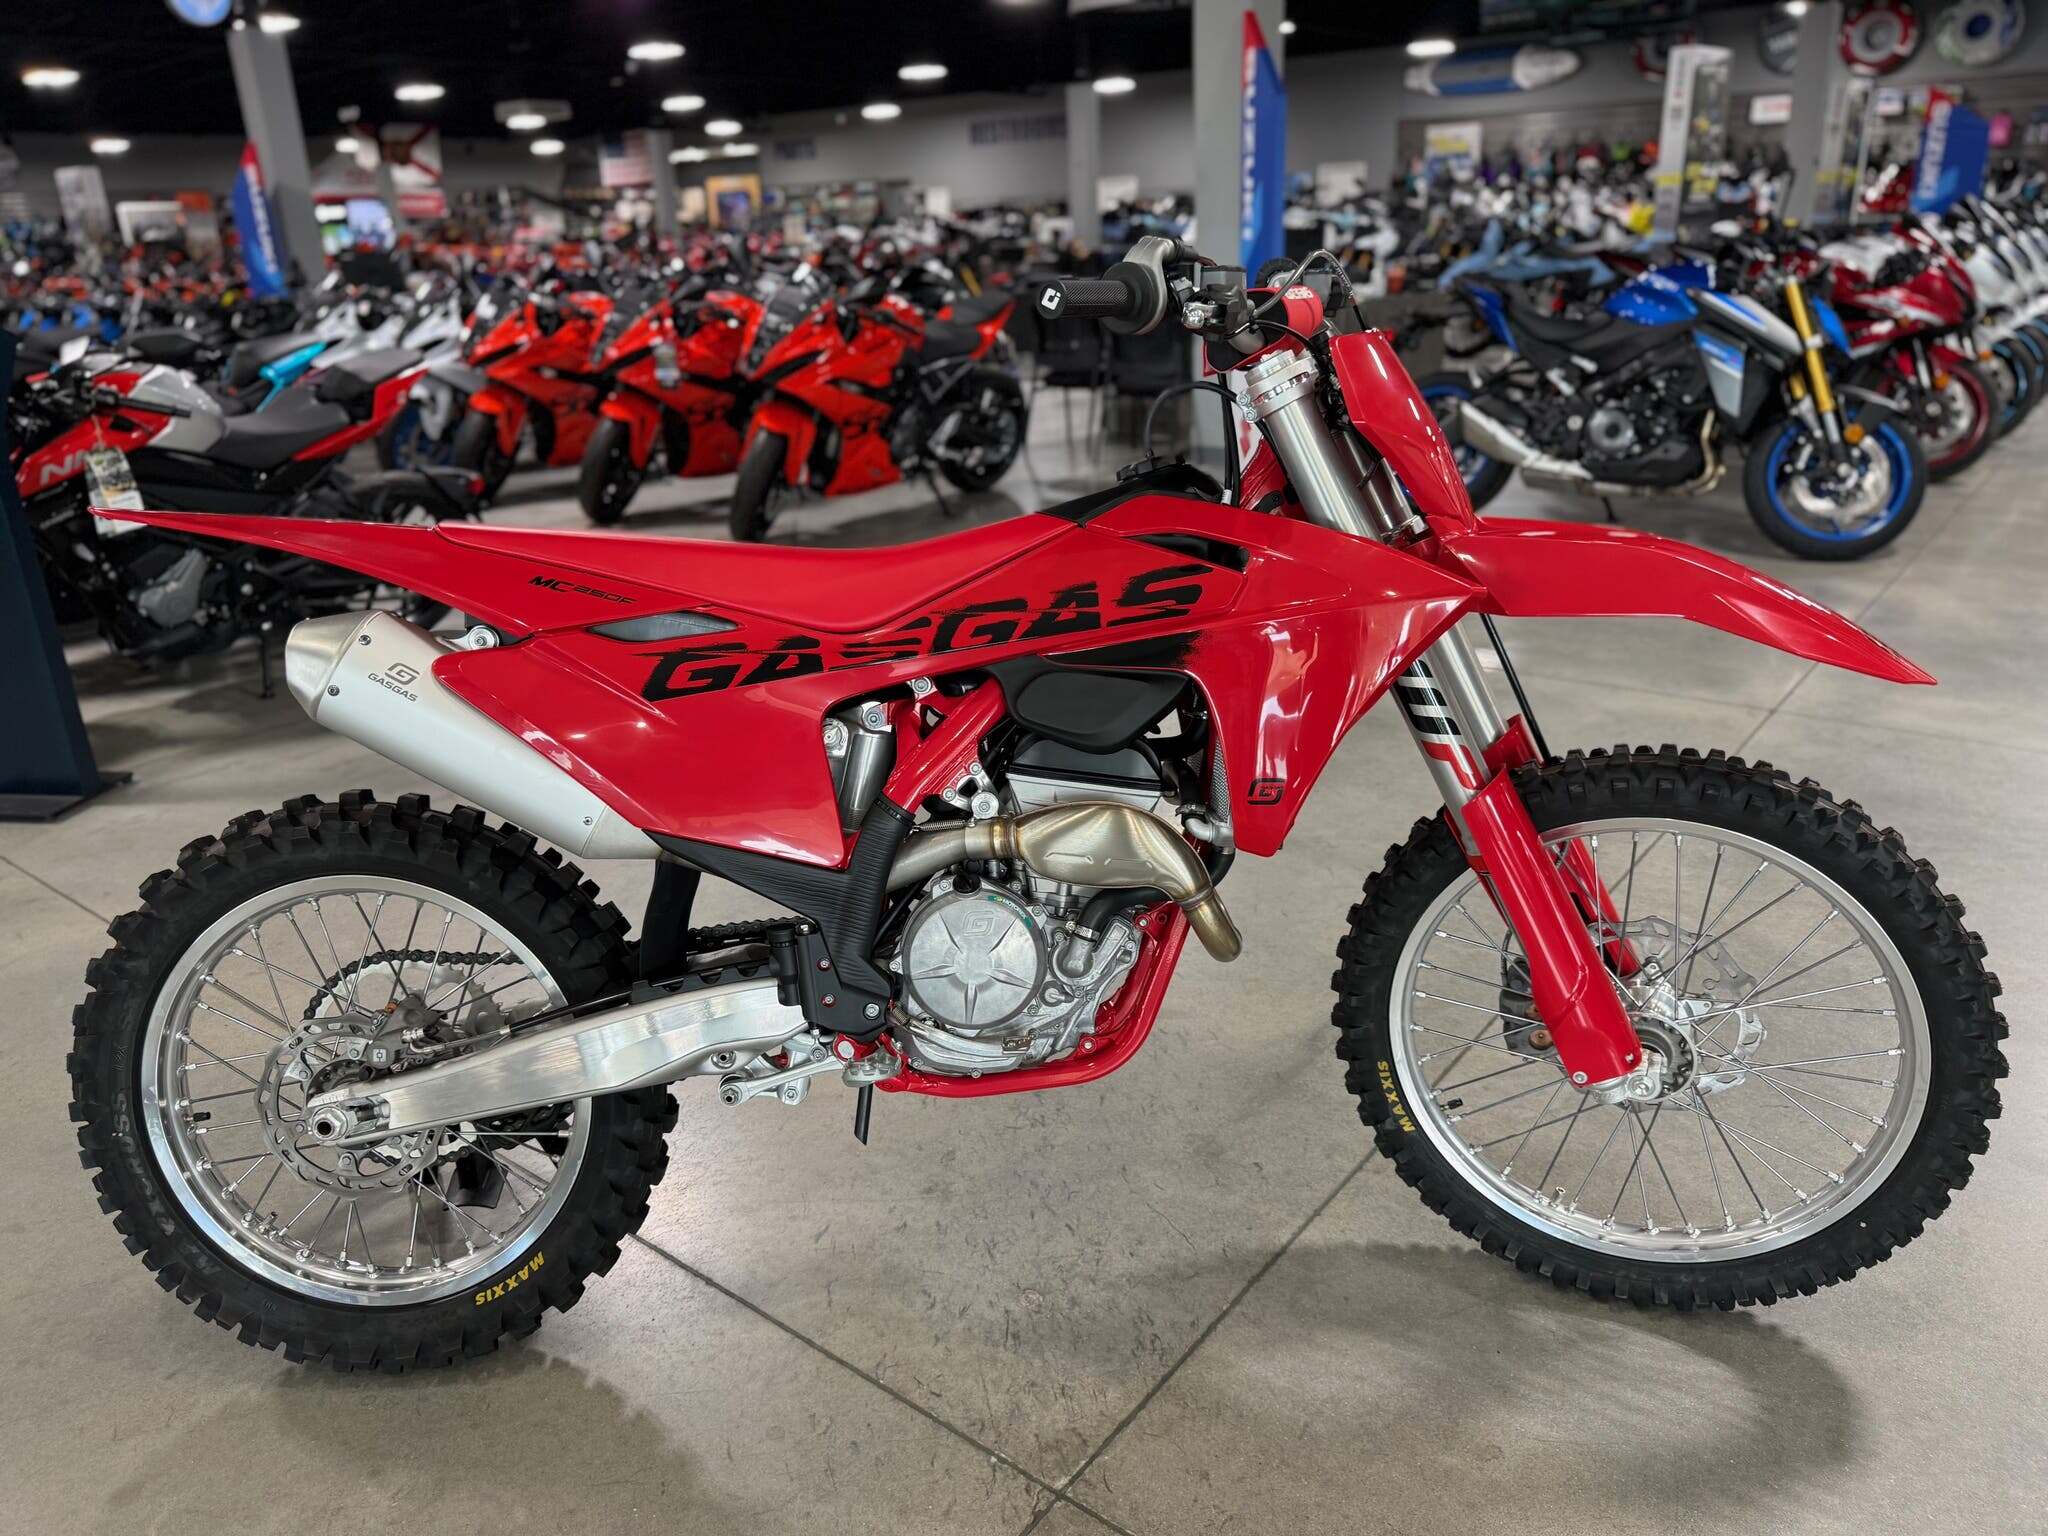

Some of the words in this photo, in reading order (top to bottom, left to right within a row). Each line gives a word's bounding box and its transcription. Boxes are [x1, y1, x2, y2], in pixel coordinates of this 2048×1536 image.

[640, 563, 1214, 702] GASGAS
[367, 672, 418, 702] GASGAS
[1377, 1060, 1416, 1132] MAXXIS
[475, 1250, 545, 1306] MAXXIS
